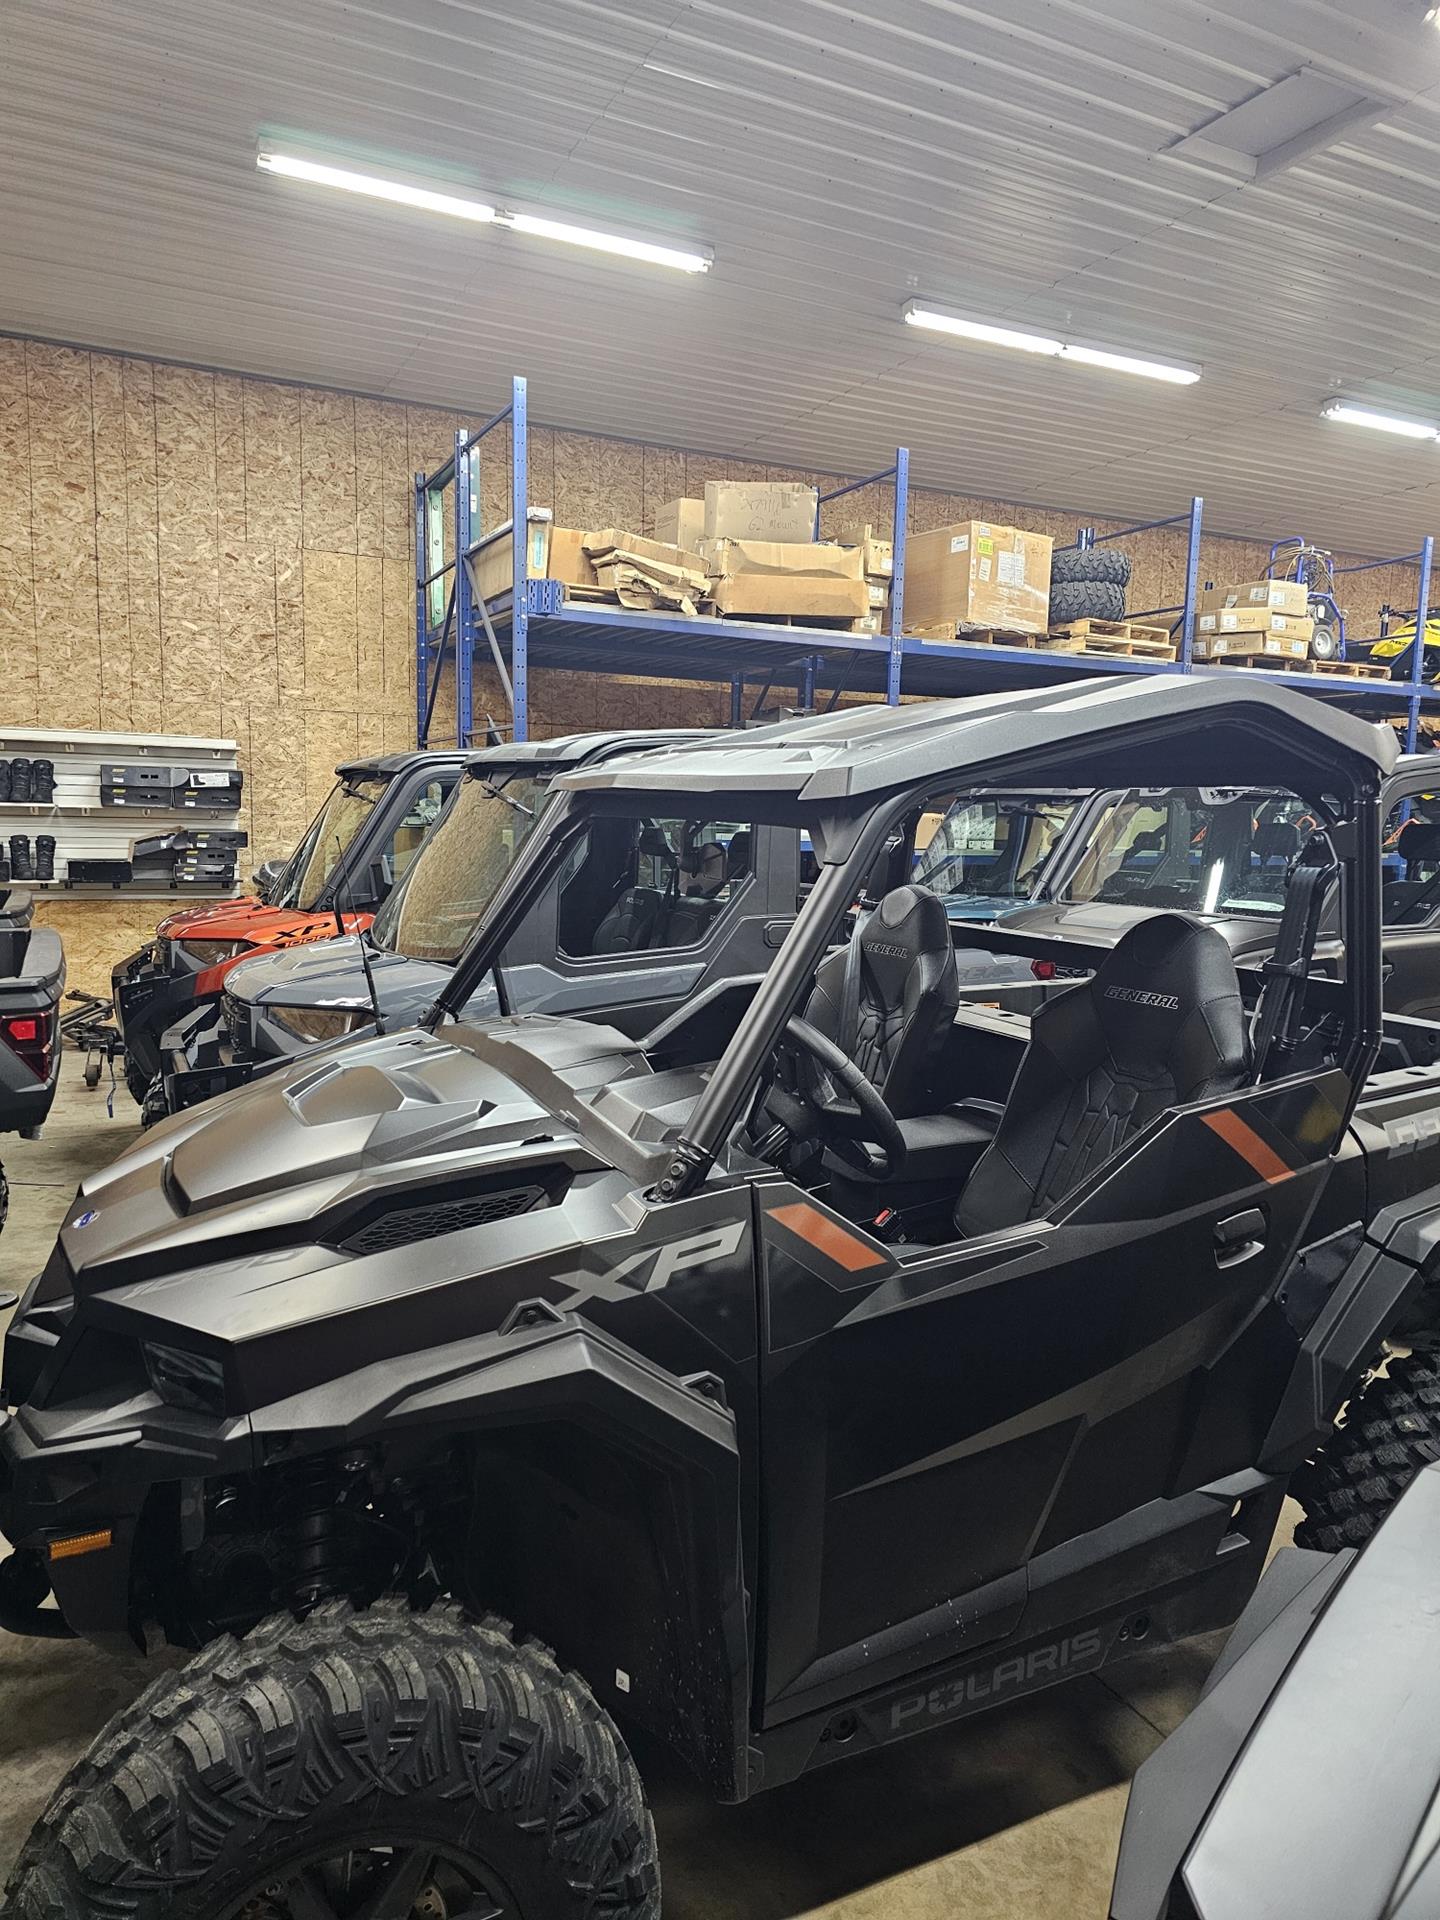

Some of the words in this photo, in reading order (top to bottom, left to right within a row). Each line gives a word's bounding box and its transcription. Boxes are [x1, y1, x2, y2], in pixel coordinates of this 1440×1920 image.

[271, 922, 331, 942] XP
[863, 941, 908, 959] GENERAL
[1104, 985, 1179, 1010] GENERAL
[550, 1219, 747, 1313] XP
[890, 1627, 1101, 1730] POLARIS
